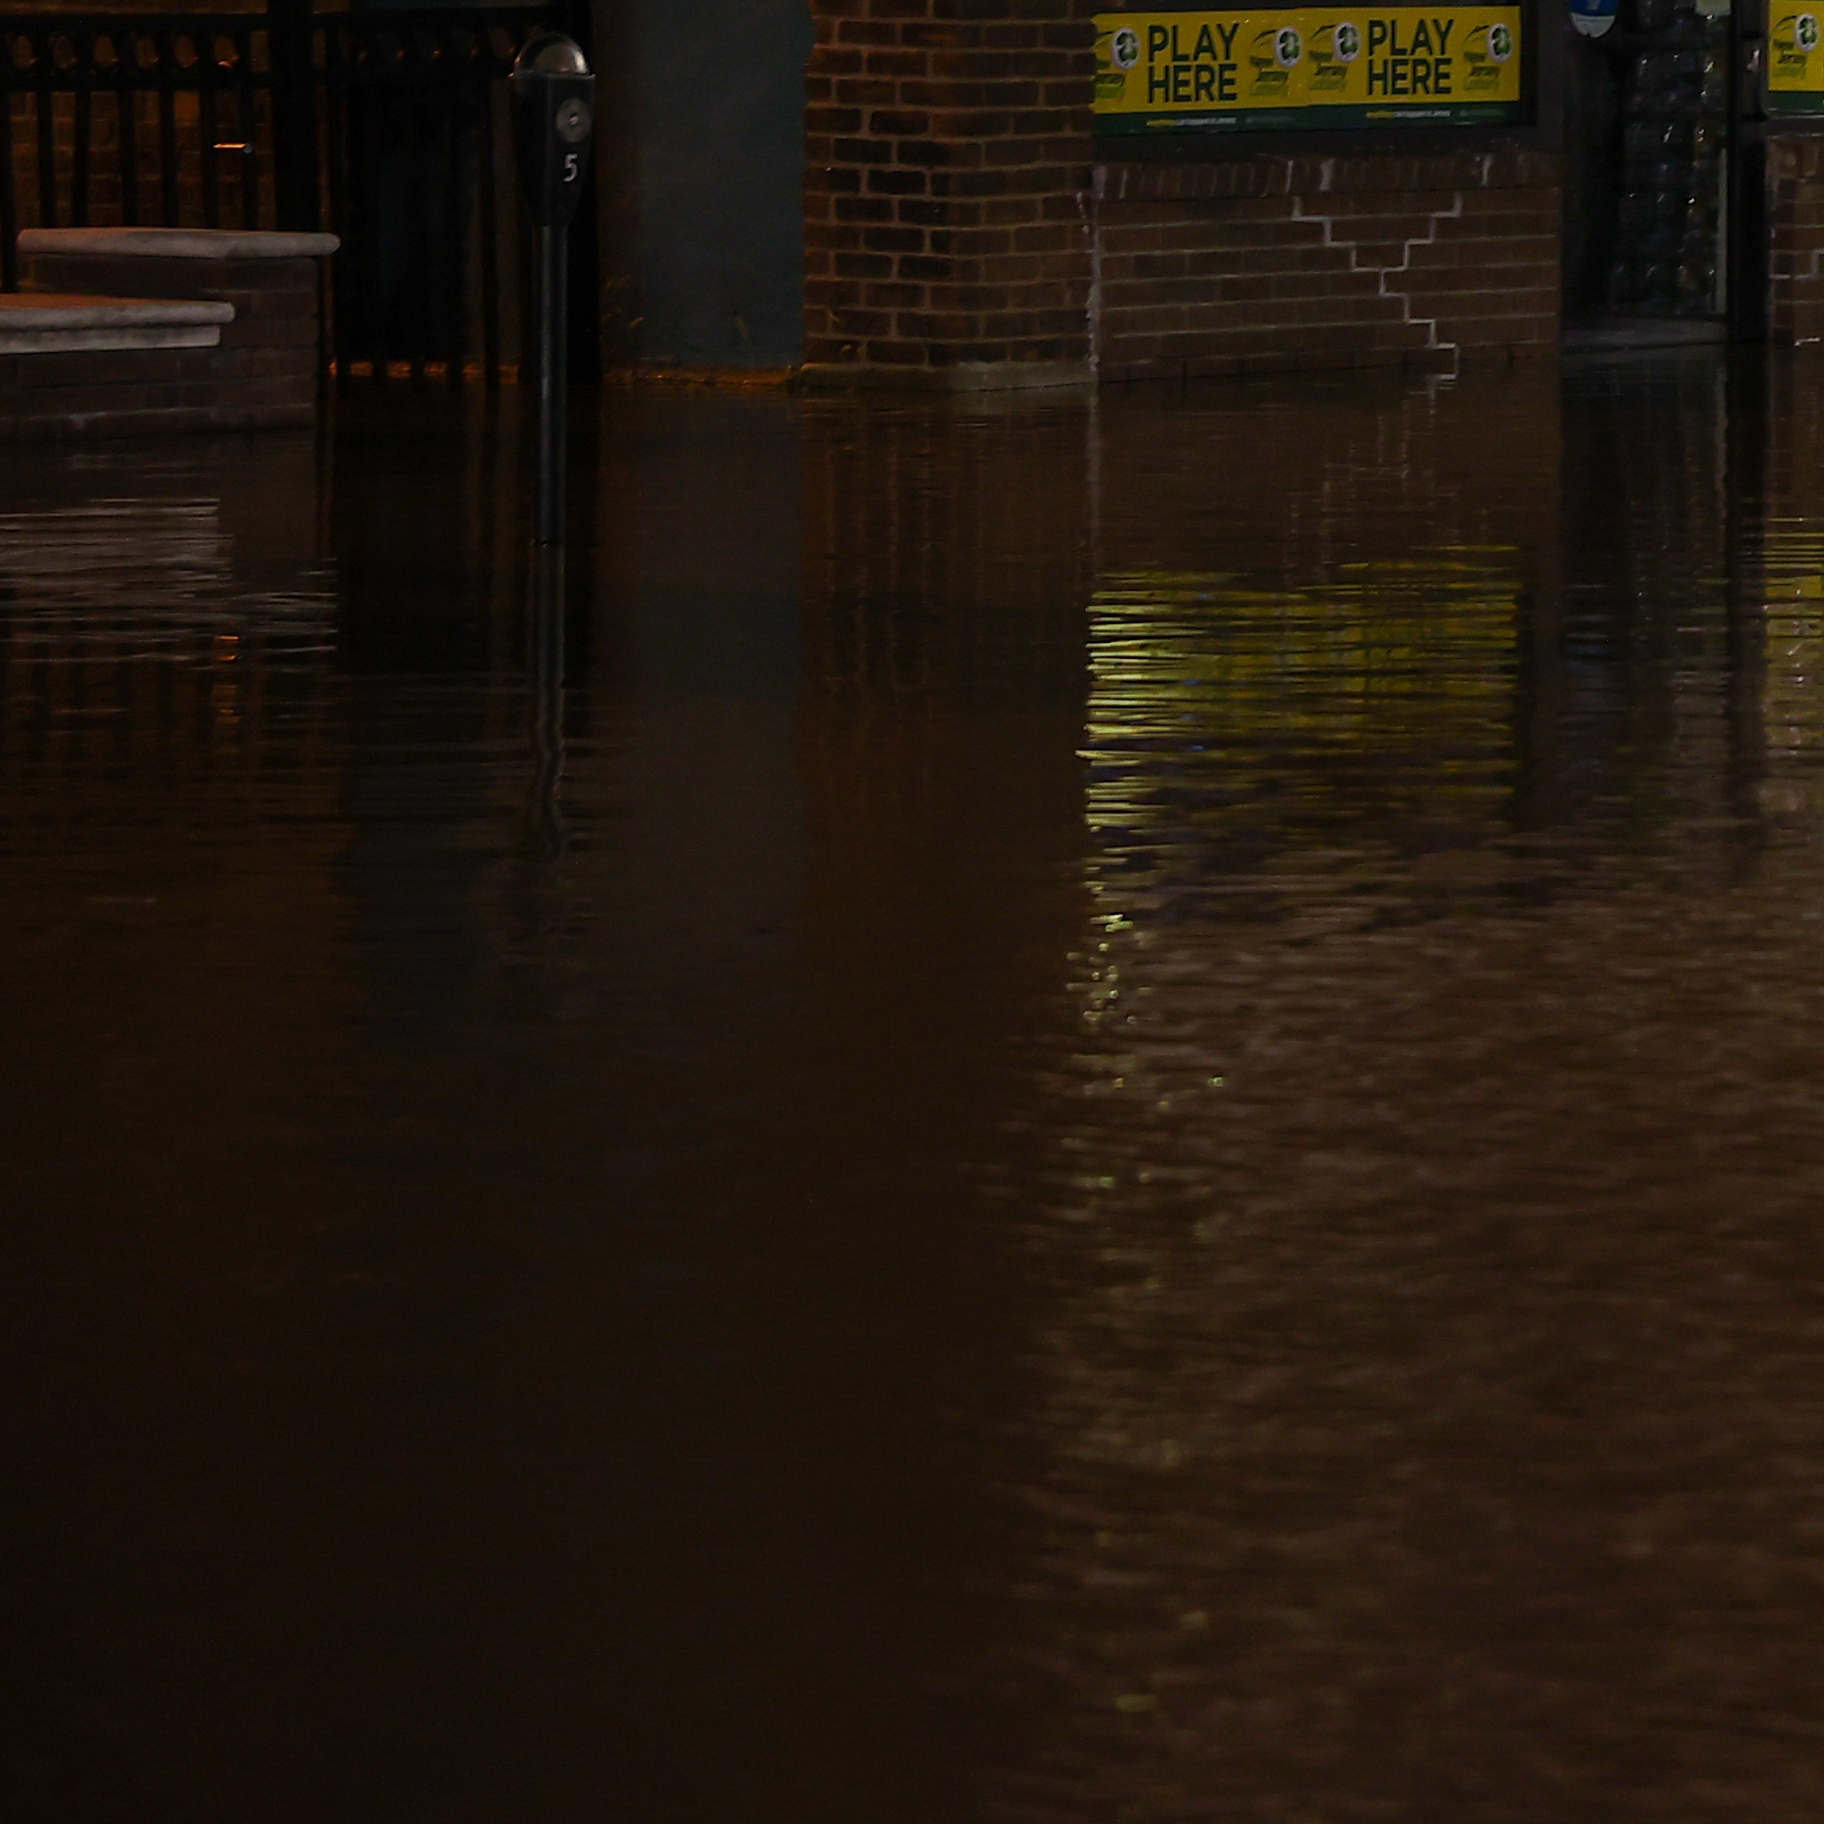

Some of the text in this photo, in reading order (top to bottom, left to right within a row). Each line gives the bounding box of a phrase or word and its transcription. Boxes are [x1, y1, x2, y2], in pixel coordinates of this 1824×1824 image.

[1147, 23, 1240, 63] PLAY
[1367, 19, 1454, 56] PLAY
[1147, 63, 1238, 104] HERE
[1367, 57, 1453, 96] HERE
[562, 152, 579, 183] 5
